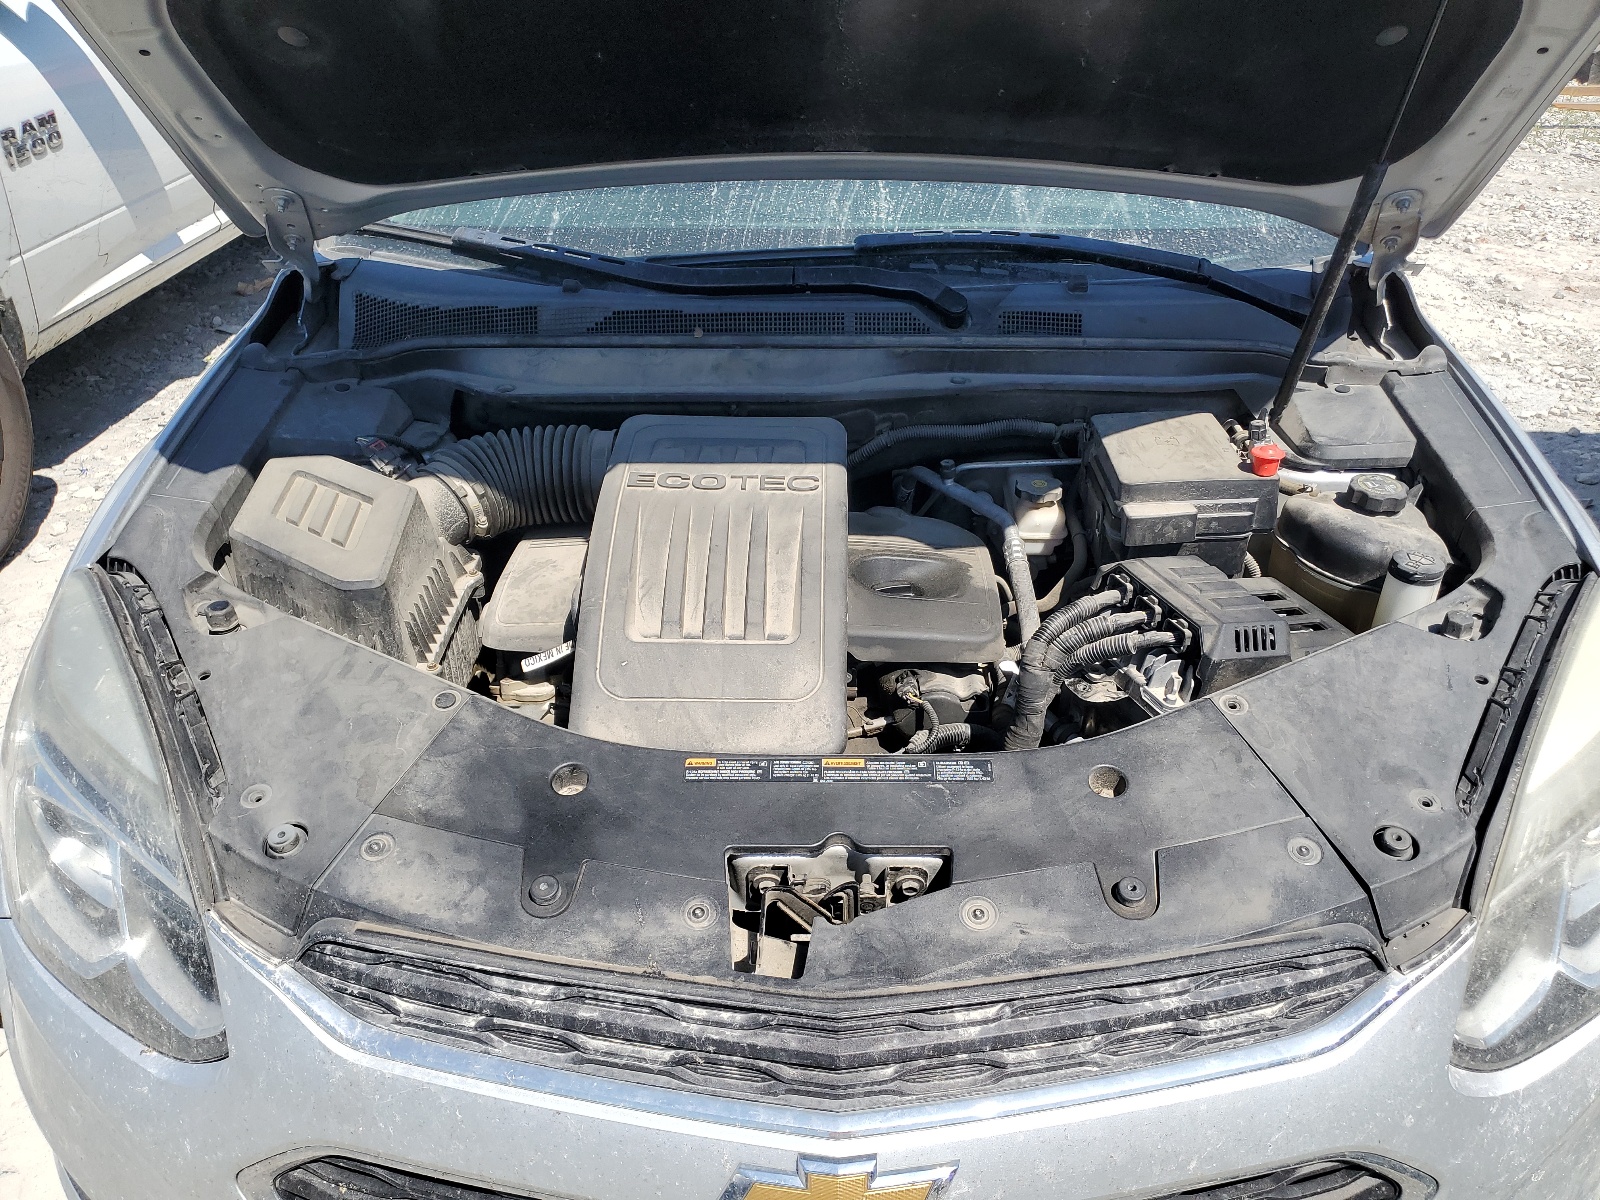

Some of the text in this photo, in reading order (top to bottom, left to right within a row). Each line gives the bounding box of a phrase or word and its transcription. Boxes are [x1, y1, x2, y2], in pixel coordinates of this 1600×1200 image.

[0, 111, 58, 148] RAM
[5, 131, 63, 171] 1500
[627, 472, 820, 491] ECOTEC
[525, 649, 554, 667] MEXICO
